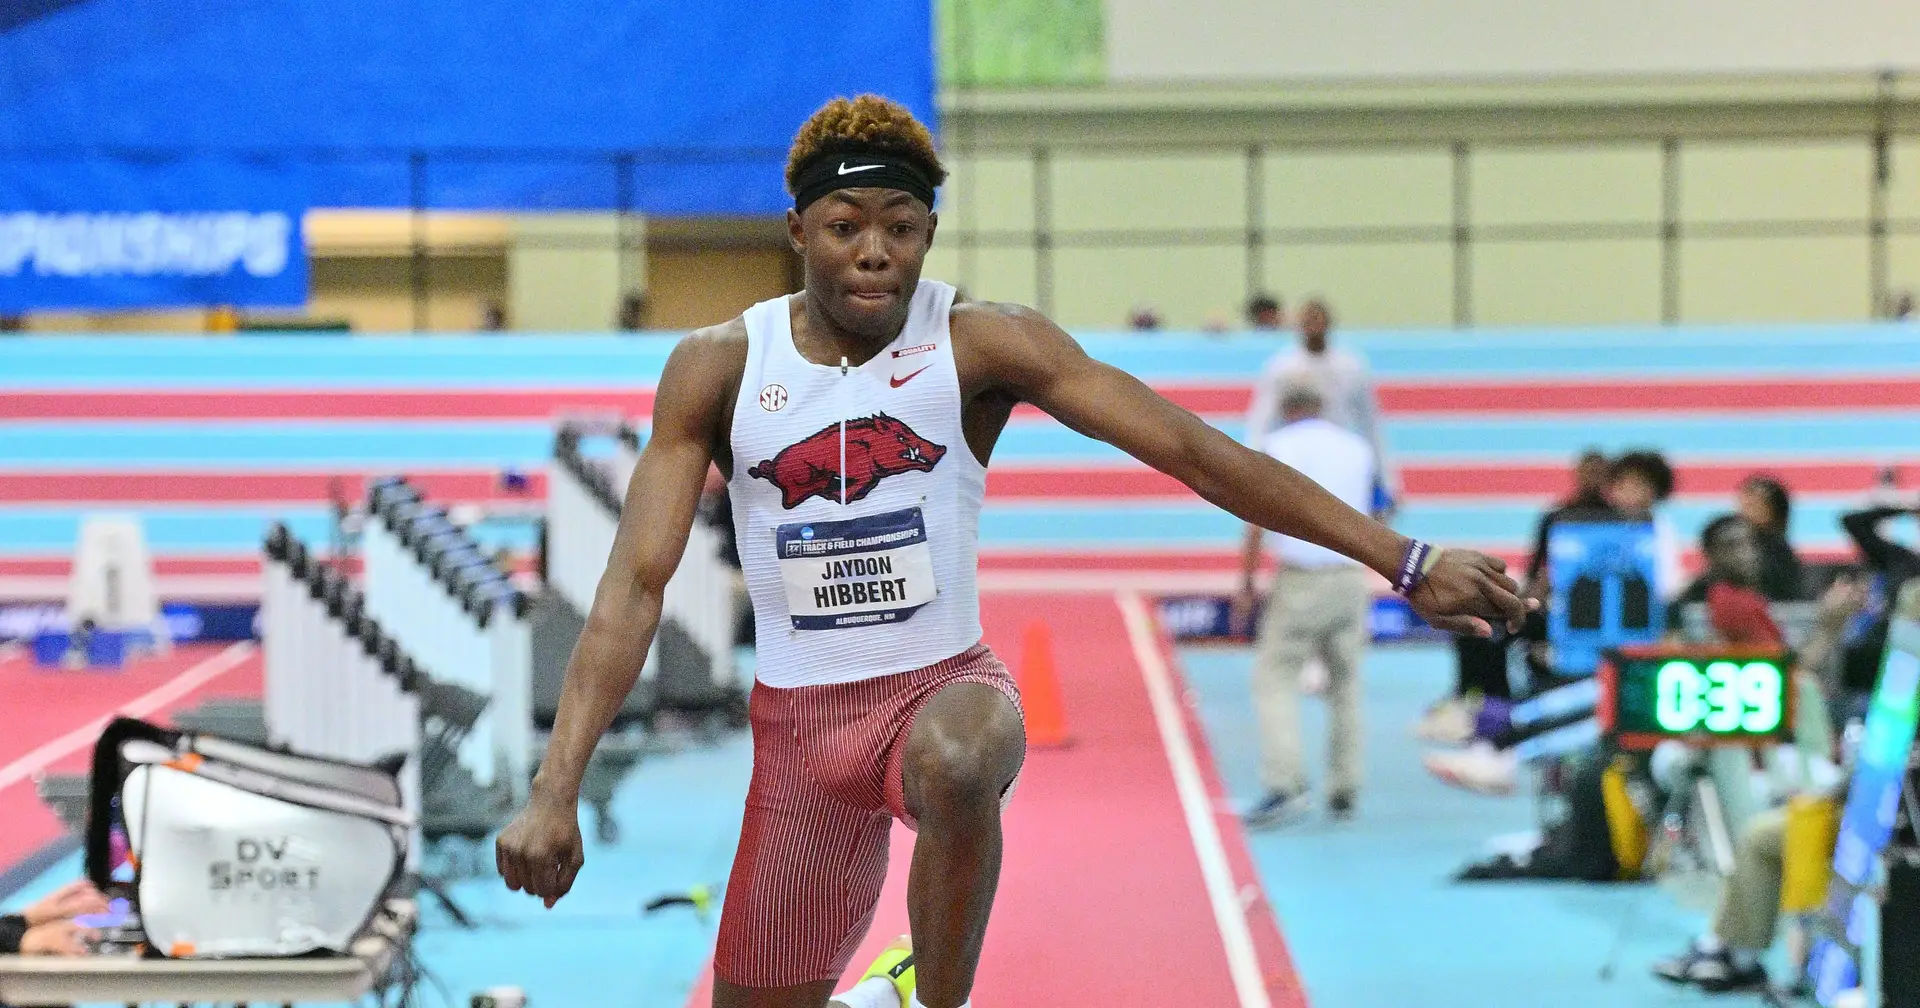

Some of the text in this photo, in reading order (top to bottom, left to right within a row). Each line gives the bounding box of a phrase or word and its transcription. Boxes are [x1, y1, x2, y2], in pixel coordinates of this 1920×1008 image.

[760, 384, 788, 412] SEC
[802, 542, 828, 552] TRACK
[828, 541, 834, 550] &
[834, 539, 855, 550] FIELD
[856, 528, 919, 548] CHAMPIONSHIPS
[821, 556, 892, 580] JAYDON
[813, 578, 906, 608] HIBBERT
[1657, 661, 1783, 732] 0:39
[236, 836, 288, 862] DV
